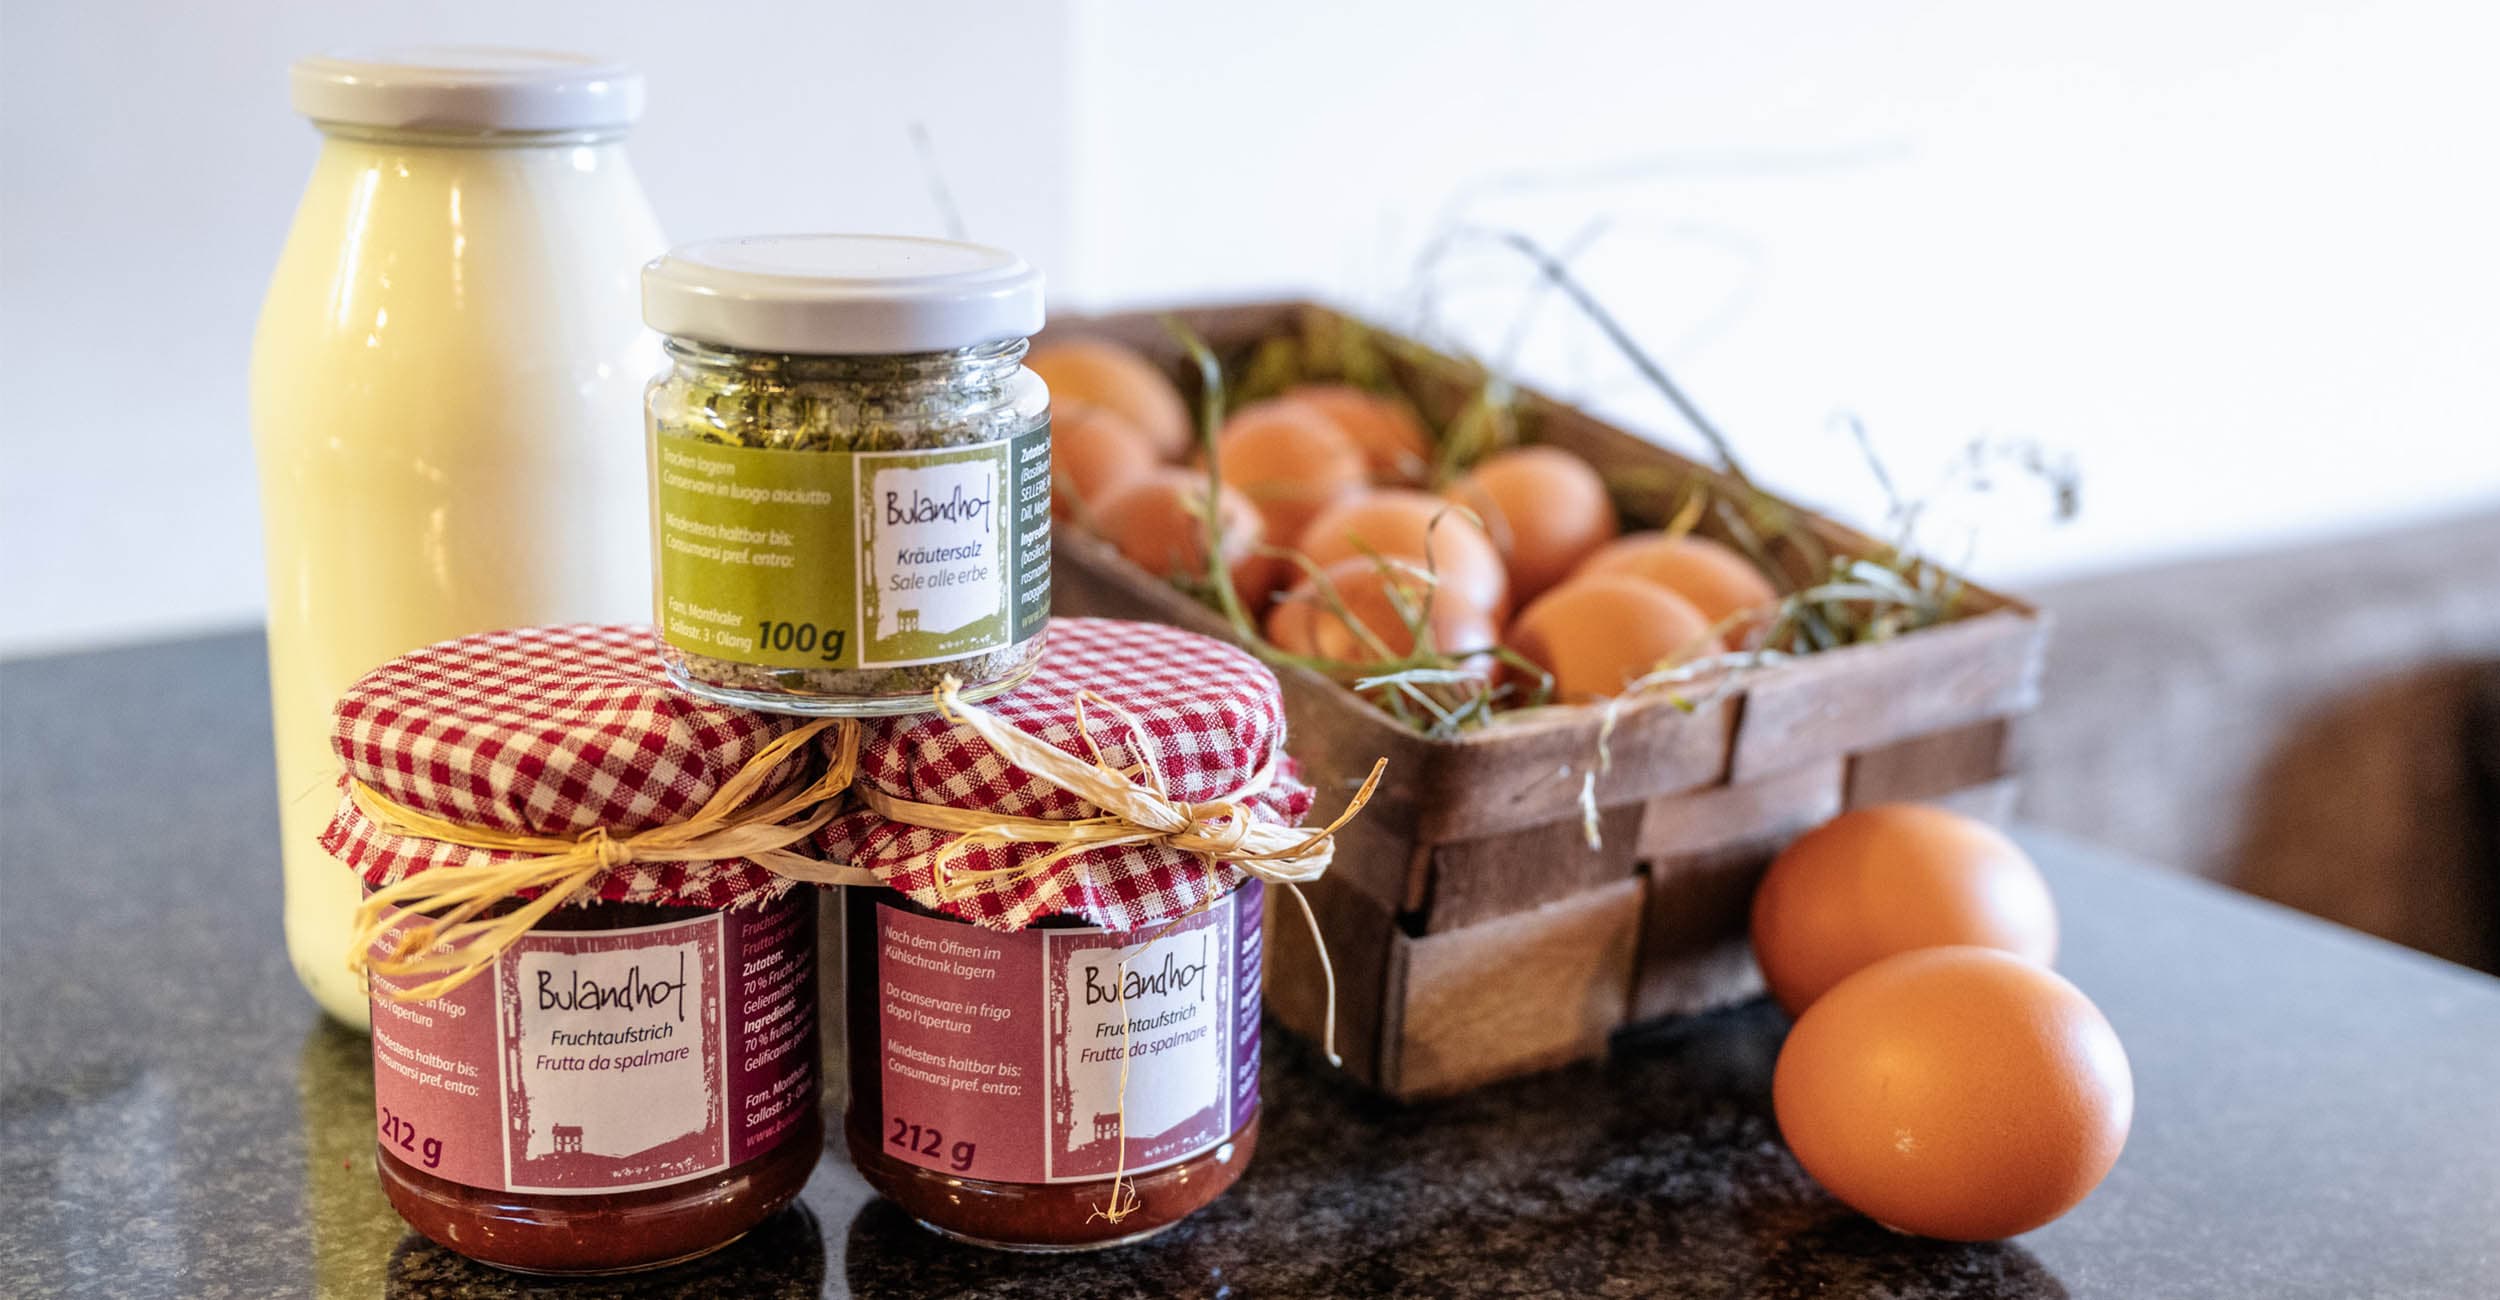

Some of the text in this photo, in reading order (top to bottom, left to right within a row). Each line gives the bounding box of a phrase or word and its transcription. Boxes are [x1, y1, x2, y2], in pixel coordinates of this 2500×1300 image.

[697, 456, 736, 477] lagern
[663, 469, 832, 506] Conservare in luogo asciutto
[886, 473, 991, 533] Bulandhof
[666, 534, 795, 568] Consumarsi pref. entro:
[718, 524, 767, 545] haltbar
[769, 530, 795, 547] bis:
[897, 540, 983, 565] Kräutersalz
[889, 564, 989, 592] Sale alle erbe
[703, 628, 710, 642] 3
[716, 631, 753, 653] Olang
[758, 620, 846, 661] 100 g
[885, 926, 1001, 961] Nach dem Öffnen im
[743, 950, 784, 977] Zutaten:
[885, 944, 996, 980] Kühlschrank lagern
[537, 951, 687, 1023] Bulandhof
[744, 980, 757, 996] 70
[758, 976, 768, 990] %
[886, 982, 1011, 1023] Da conservare in frigo
[438, 998, 467, 1019] frigo
[744, 996, 796, 1035] Ingredienti:
[886, 1004, 971, 1034] dopo l'apertura
[1096, 1004, 1196, 1038] Fruchtaufstrich
[551, 1022, 674, 1047] Fruchtaufstrich
[745, 1037, 757, 1053] 70
[1128, 1042, 1147, 1058] da
[1150, 1024, 1208, 1056] spalmare
[377, 1045, 479, 1097] Consumarsi pref. entro:
[415, 1046, 455, 1073] haltbar
[457, 1058, 479, 1078] bis:
[536, 1045, 690, 1073] Frutta da spalmare
[887, 1039, 1022, 1077] Mindestens haltbar bis:
[888, 1057, 1022, 1096] Consumarsi pref. entro:
[745, 1090, 771, 1109] Fam.
[382, 1107, 443, 1169] 212 g
[889, 1117, 976, 1171] 212 g
